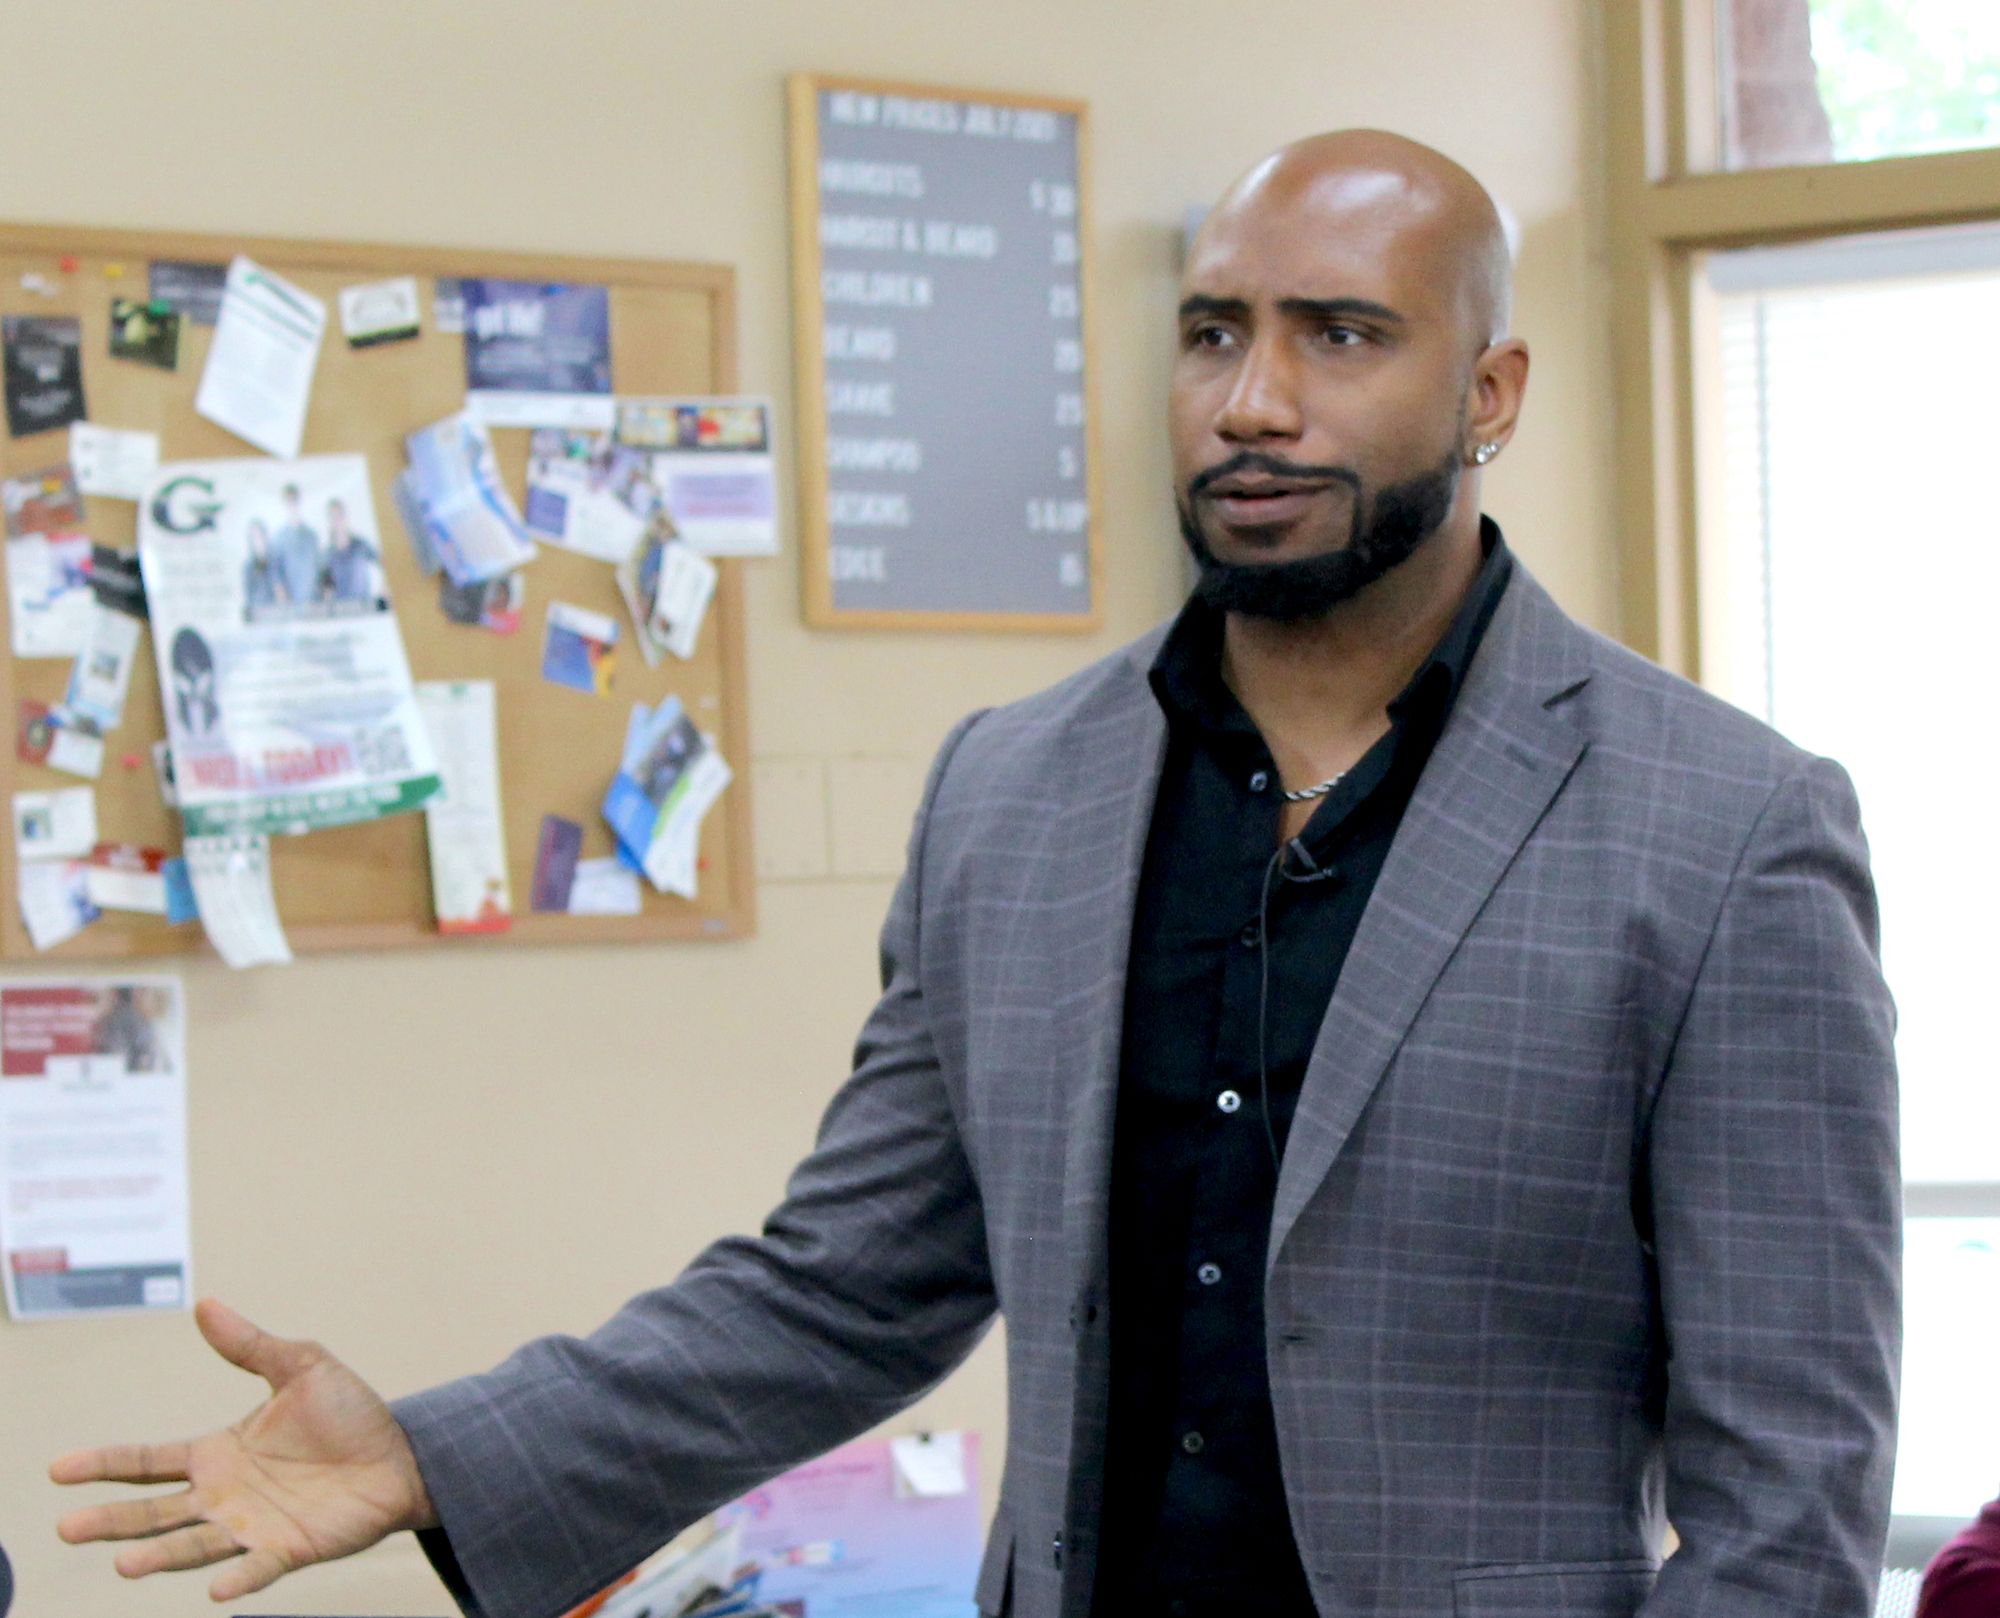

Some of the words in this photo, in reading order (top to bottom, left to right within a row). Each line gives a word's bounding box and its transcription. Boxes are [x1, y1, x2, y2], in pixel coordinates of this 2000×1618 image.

[830, 92, 878, 123] NEW
[882, 97, 958, 134] PRICES
[923, 221, 997, 259] BEARD
[823, 270, 932, 306] CHILDREN
[823, 326, 895, 361] BEARD
[151, 475, 224, 536] G
